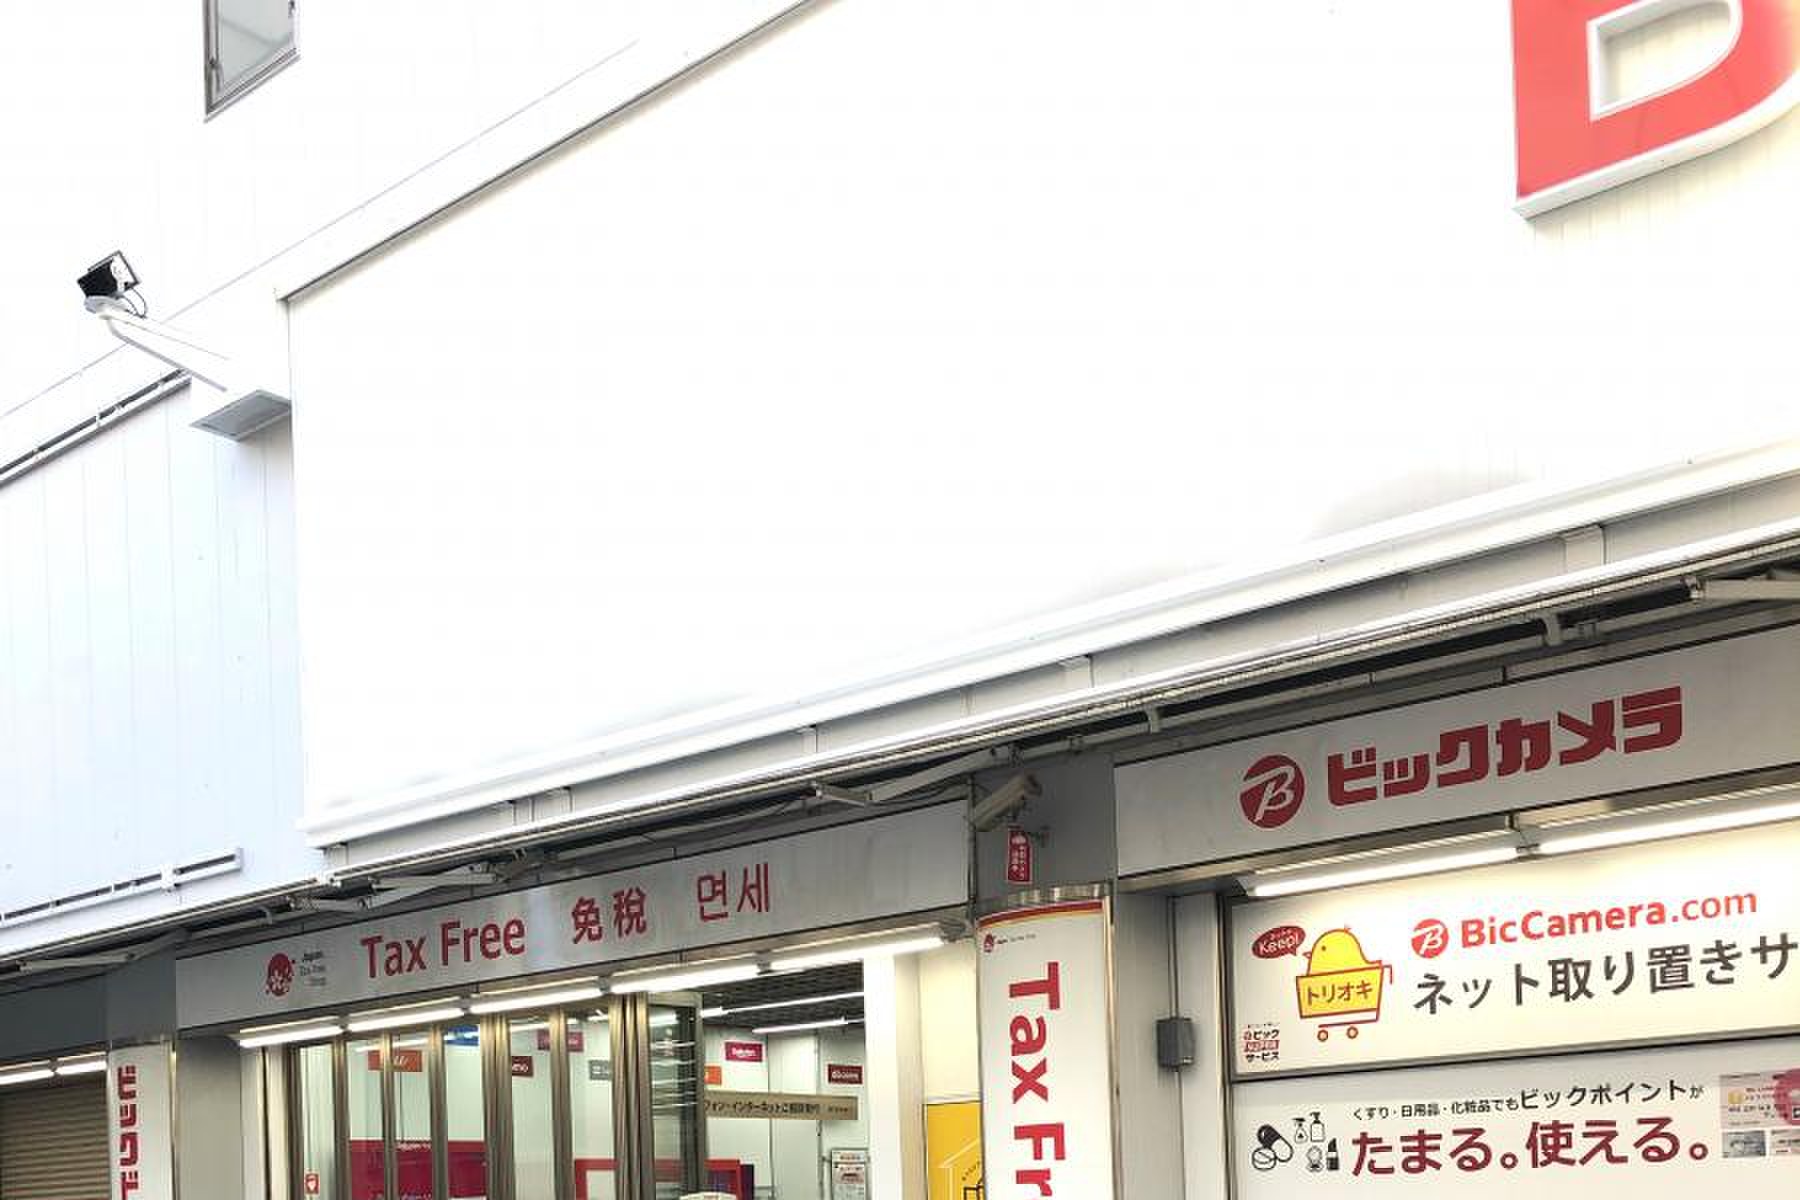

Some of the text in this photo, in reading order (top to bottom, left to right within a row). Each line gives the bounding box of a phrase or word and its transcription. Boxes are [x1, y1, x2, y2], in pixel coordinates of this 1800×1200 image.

[1327, 686, 1682, 807] ビックカメラ
[696, 863, 770, 922] 면세
[1460, 892, 1757, 948] BicCamera.com
[360, 917, 525, 978] Tax Free
[1413, 932, 1799, 1014] ネット取り置きサ
[1306, 979, 1374, 1006] トリオキ
[1008, 961, 1061, 1104] Tax
